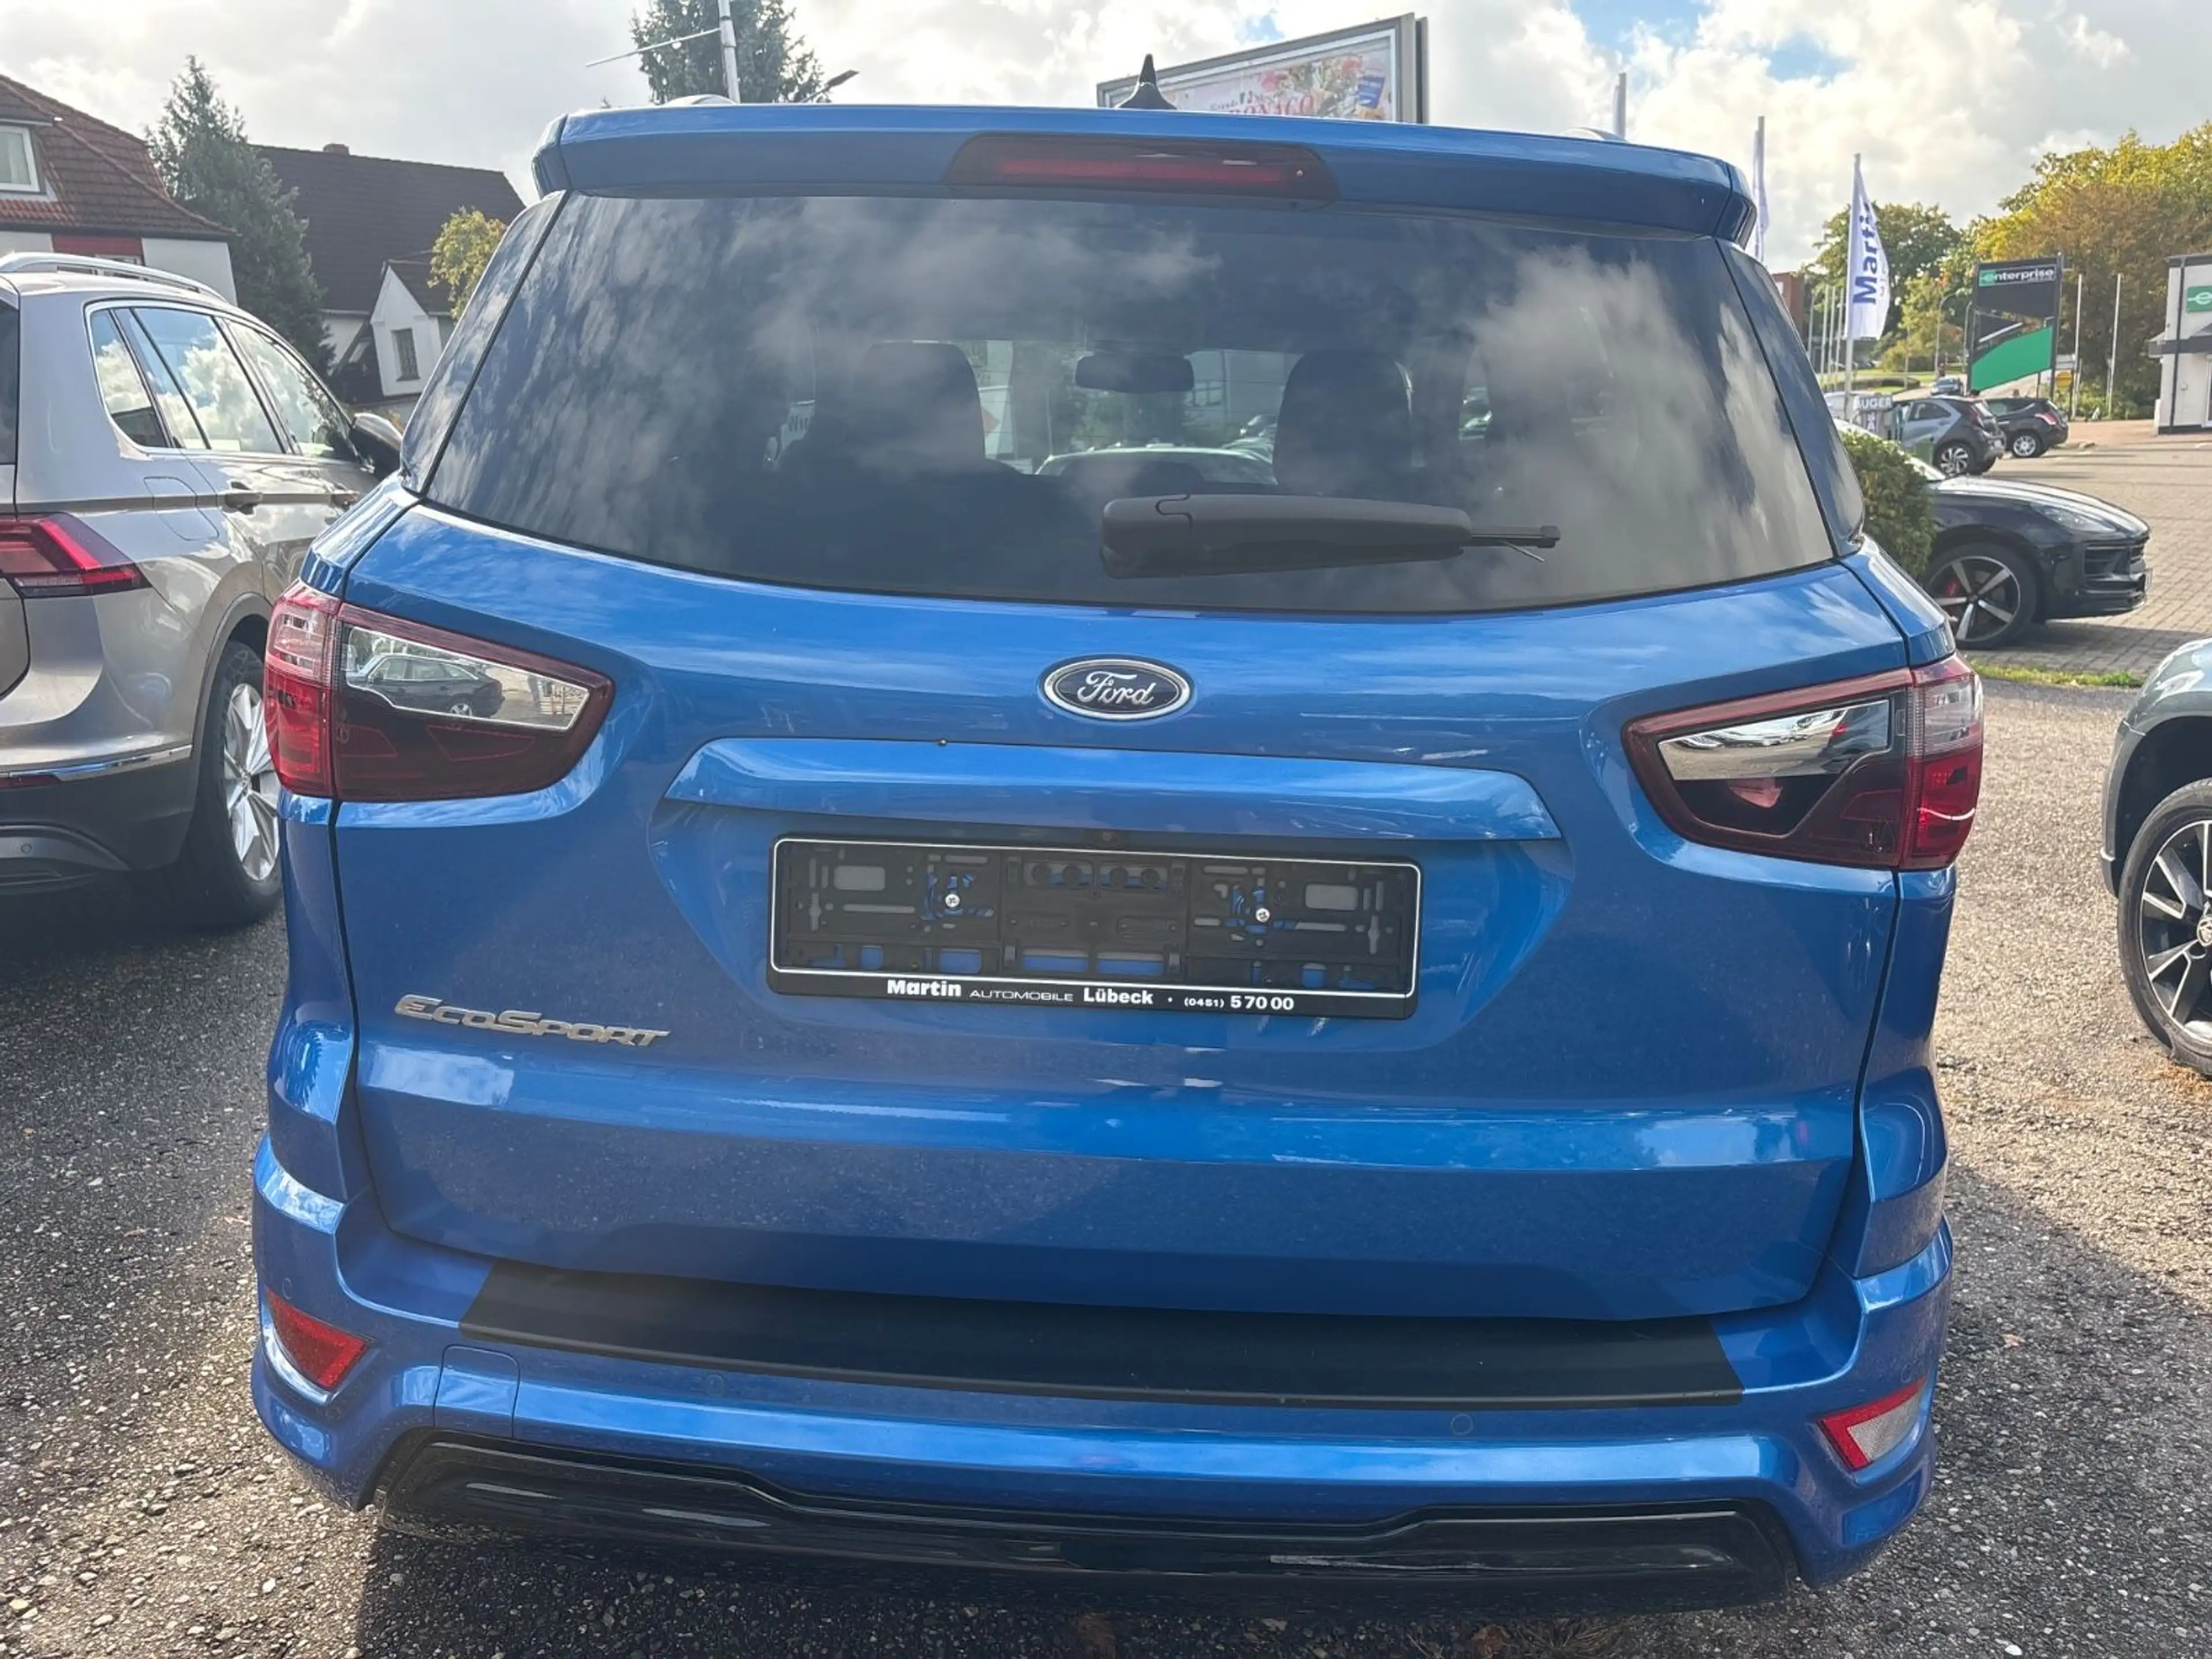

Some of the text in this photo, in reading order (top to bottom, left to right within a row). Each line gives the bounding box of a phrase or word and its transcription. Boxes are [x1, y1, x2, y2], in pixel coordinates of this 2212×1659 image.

[1077, 671, 1156, 704] Ford
[887, 980, 961, 996] Martin
[969, 990, 1073, 1001] AUTOMOBILE
[1084, 987, 1153, 1004] Lübeck
[1184, 998, 1225, 1007] (0451)
